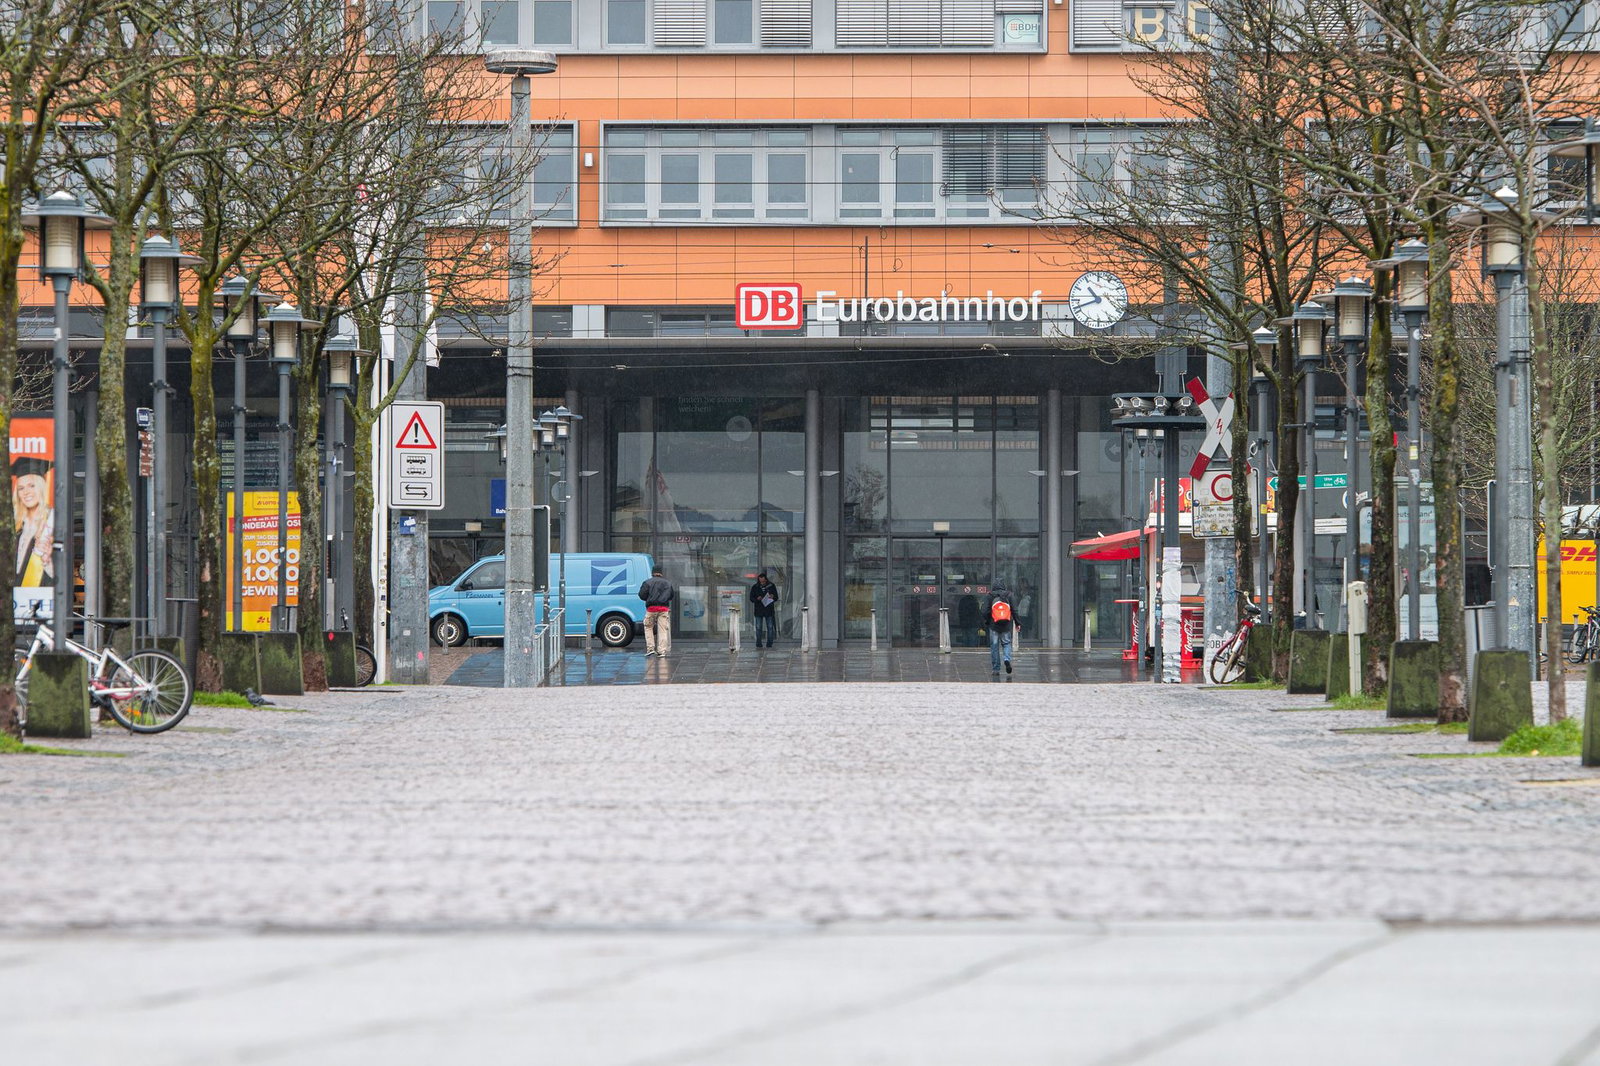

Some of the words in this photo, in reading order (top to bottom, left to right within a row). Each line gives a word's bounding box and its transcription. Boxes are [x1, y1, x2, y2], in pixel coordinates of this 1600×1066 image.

[1018, 23, 1038, 31] BDH
[743, 289, 796, 322] DB
[816, 289, 1043, 322] Eurobahnhof
